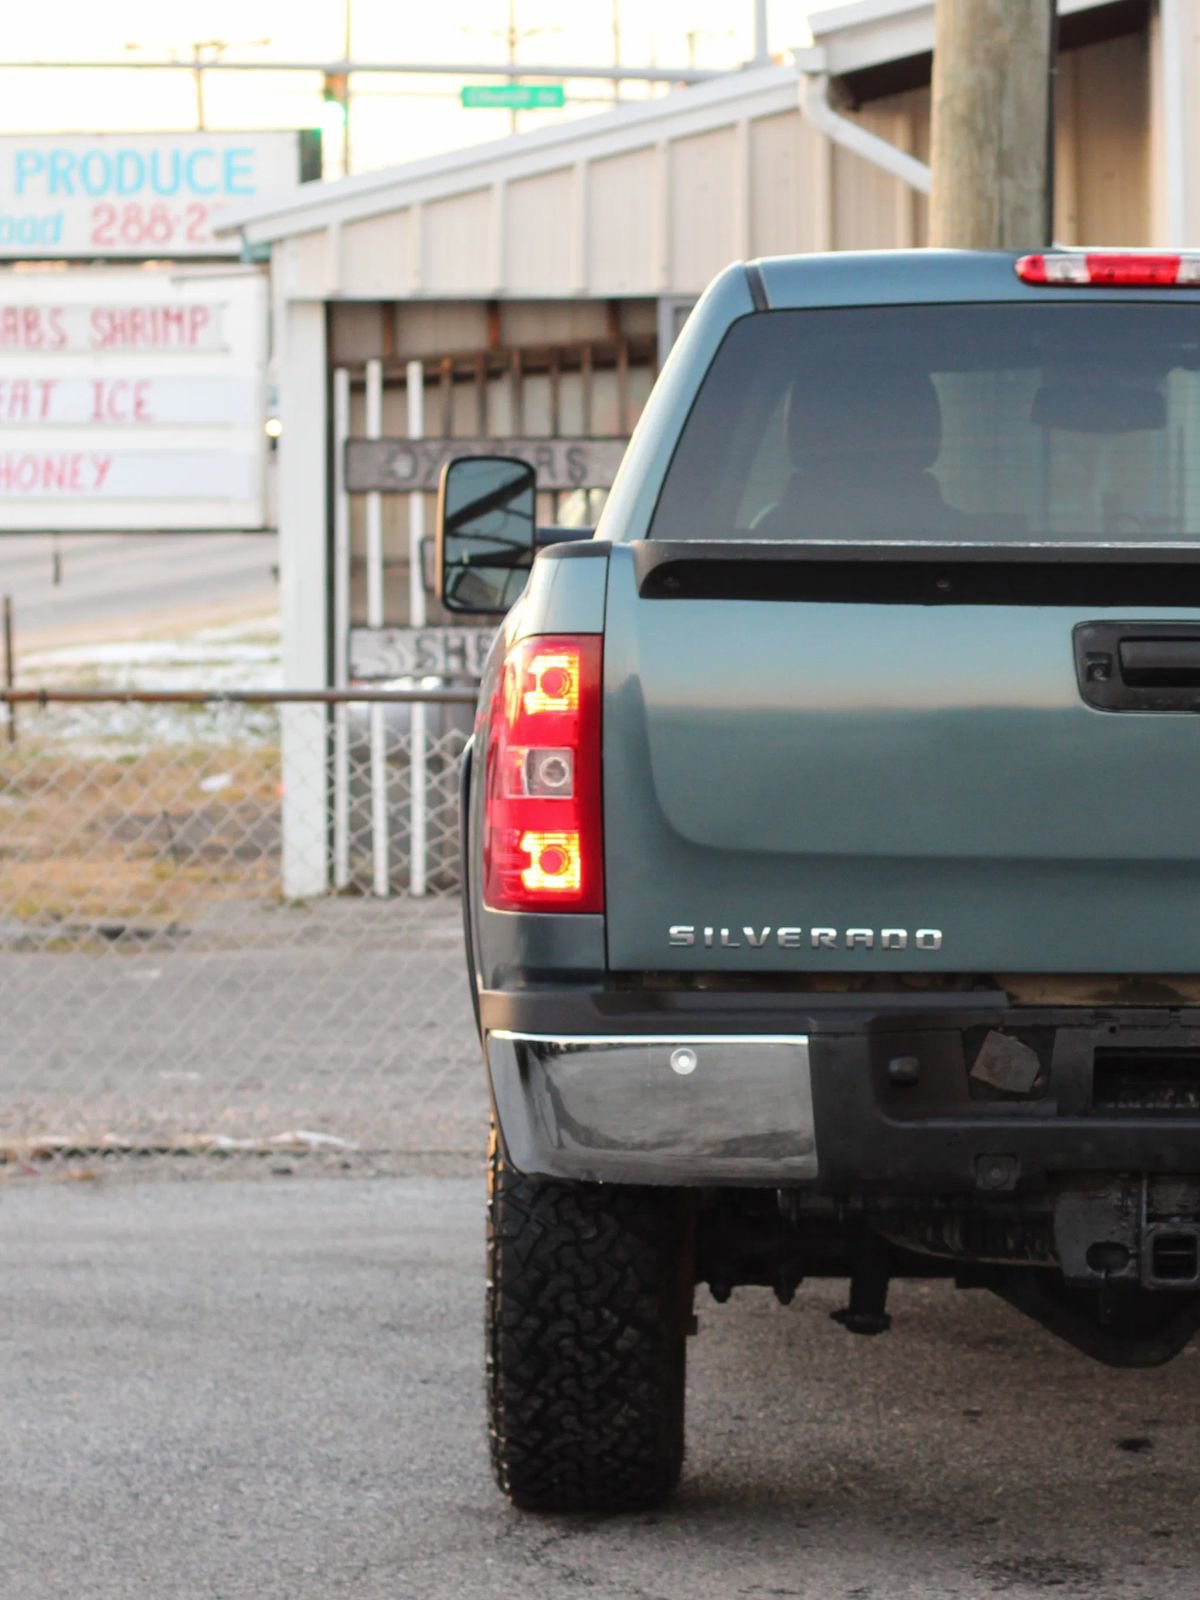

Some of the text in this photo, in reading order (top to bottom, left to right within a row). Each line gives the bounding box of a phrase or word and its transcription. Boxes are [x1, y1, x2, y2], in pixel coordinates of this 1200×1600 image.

[15, 147, 256, 196] PRODUCE
[89, 303, 210, 350] SHRIMP
[89, 377, 153, 423] ICE
[668, 925, 943, 950] SILVERADO
